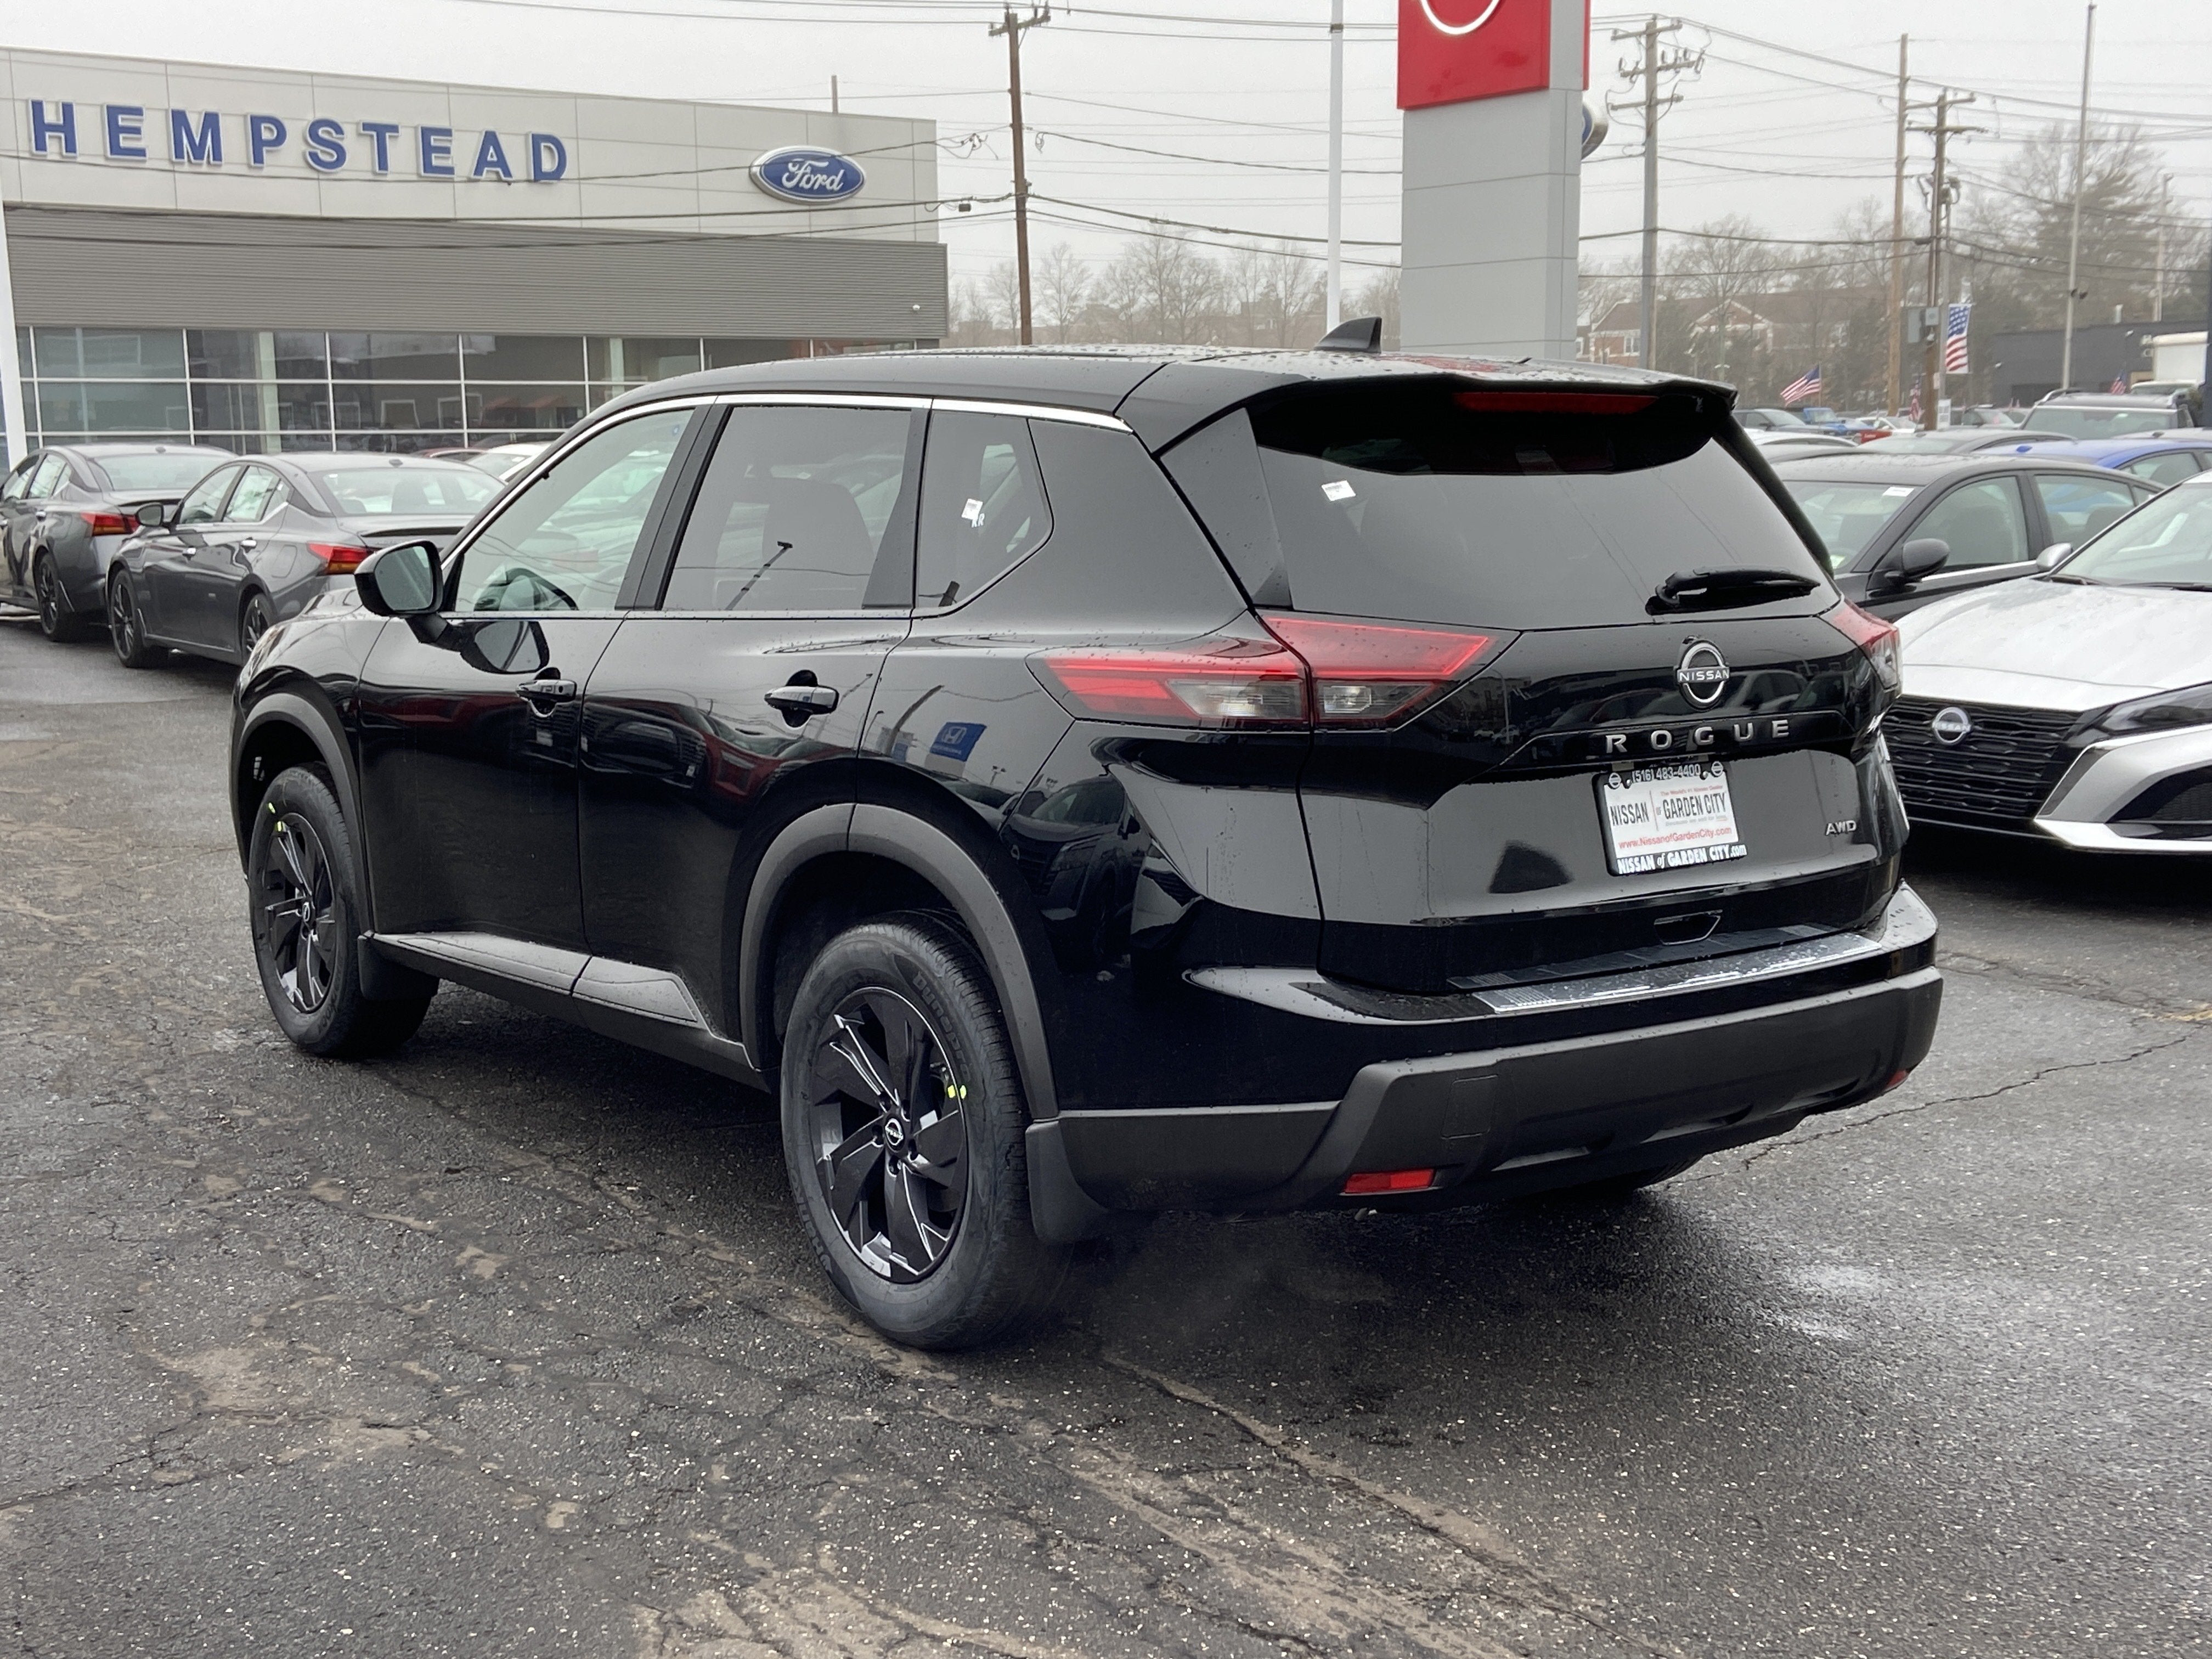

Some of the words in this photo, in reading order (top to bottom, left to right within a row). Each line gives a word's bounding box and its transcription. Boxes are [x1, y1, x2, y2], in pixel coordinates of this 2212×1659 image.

[29, 99, 567, 182] HEMPSTEAD
[782, 158, 845, 191] Ford
[1679, 669, 1730, 682] NISSAN
[1605, 719, 1790, 754] ROGUE
[1632, 769, 1654, 783] (516)
[1656, 764, 1701, 780] 483-4400
[1610, 801, 1650, 826] NISSAN
[1663, 794, 1703, 819] GARDEN
[1703, 792, 1726, 814] CITY
[1618, 827, 1732, 849] www.NissanofGardenCity.com
[1825, 820, 1857, 835] AWD
[1617, 855, 1656, 874] NISSAN
[1657, 853, 1666, 869] of
[1667, 848, 1707, 867] GARDEN
